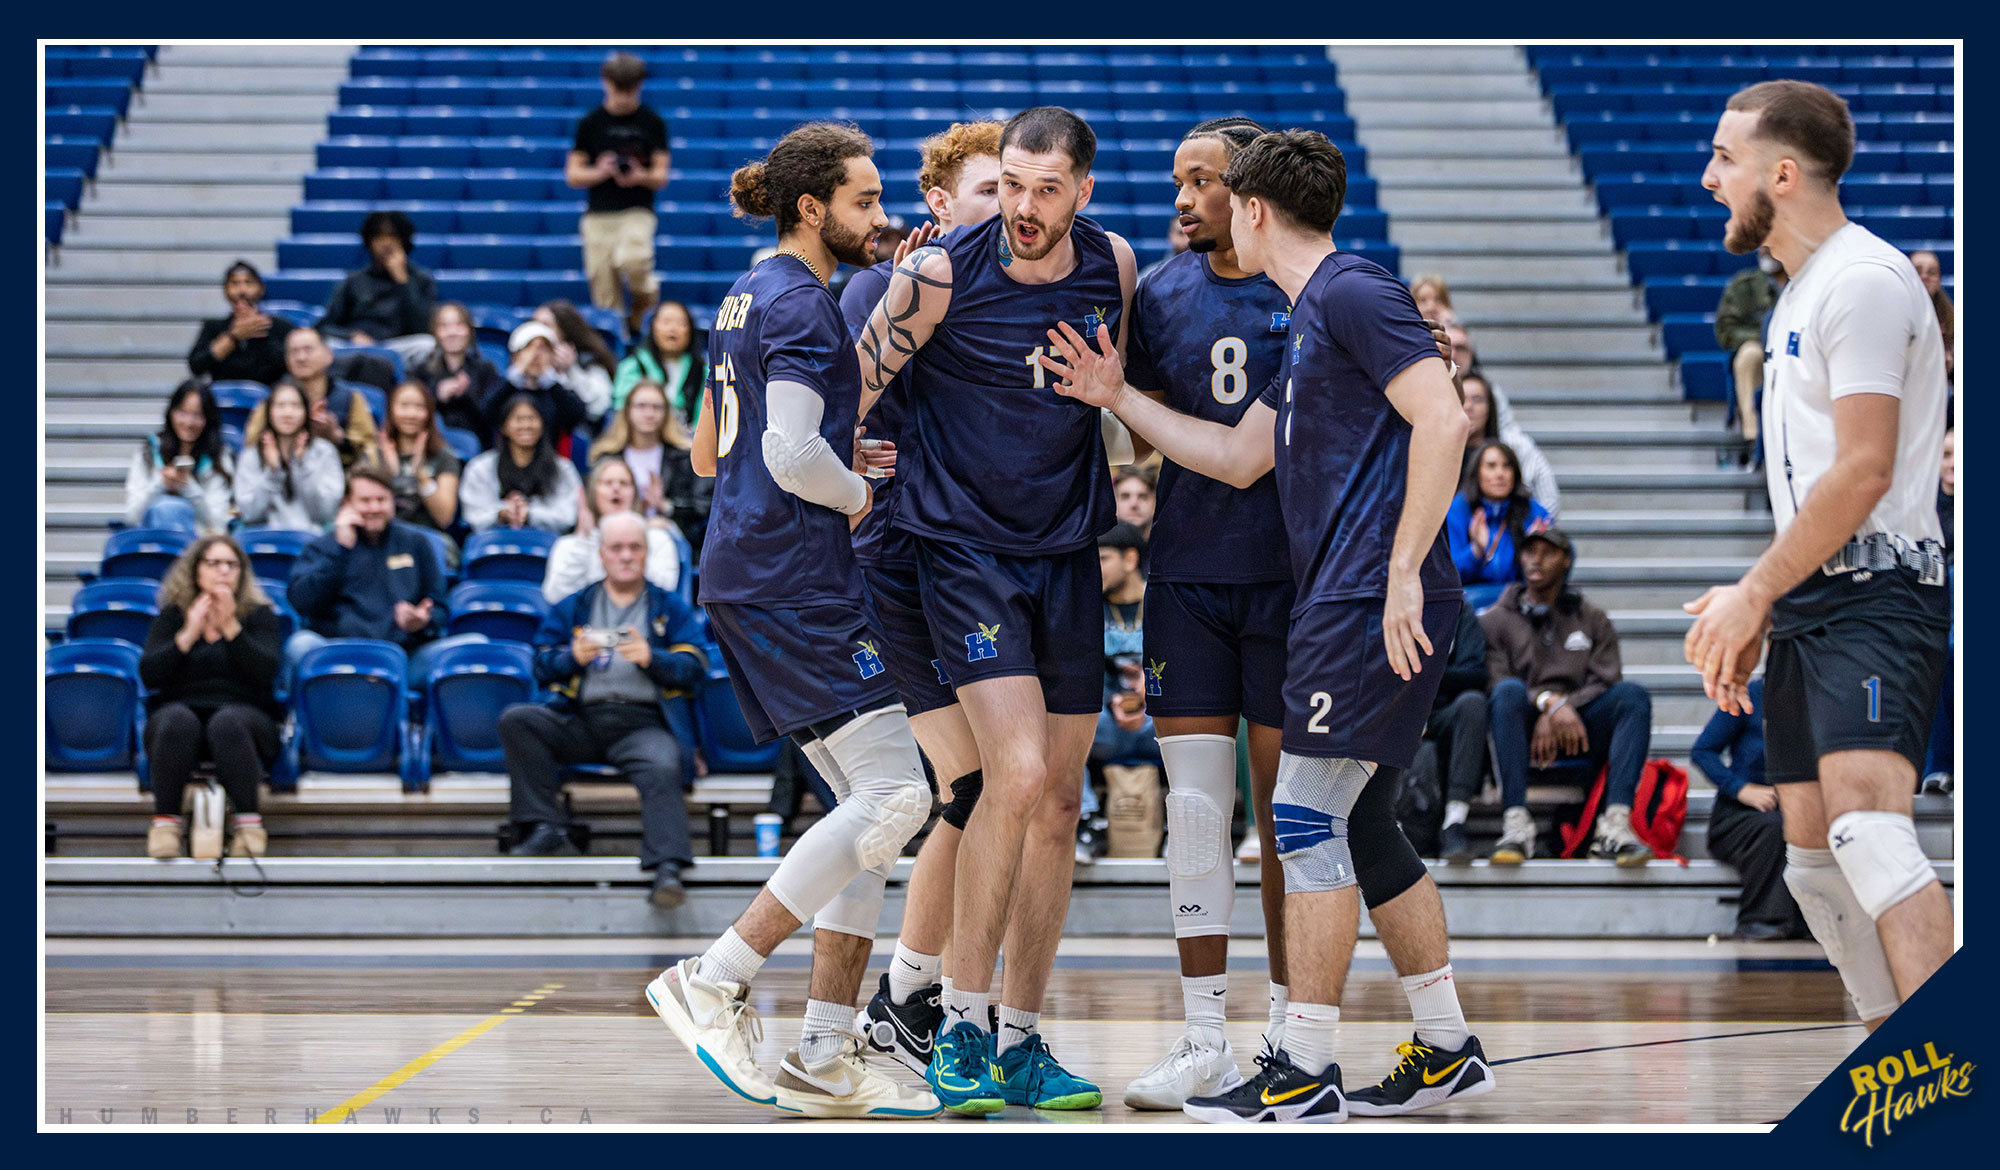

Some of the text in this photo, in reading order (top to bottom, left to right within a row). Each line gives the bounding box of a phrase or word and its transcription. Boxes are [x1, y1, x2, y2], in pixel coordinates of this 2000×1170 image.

[1211, 336, 1248, 405] 8
[1308, 691, 1332, 734] 2
[1862, 675, 1881, 722] 1
